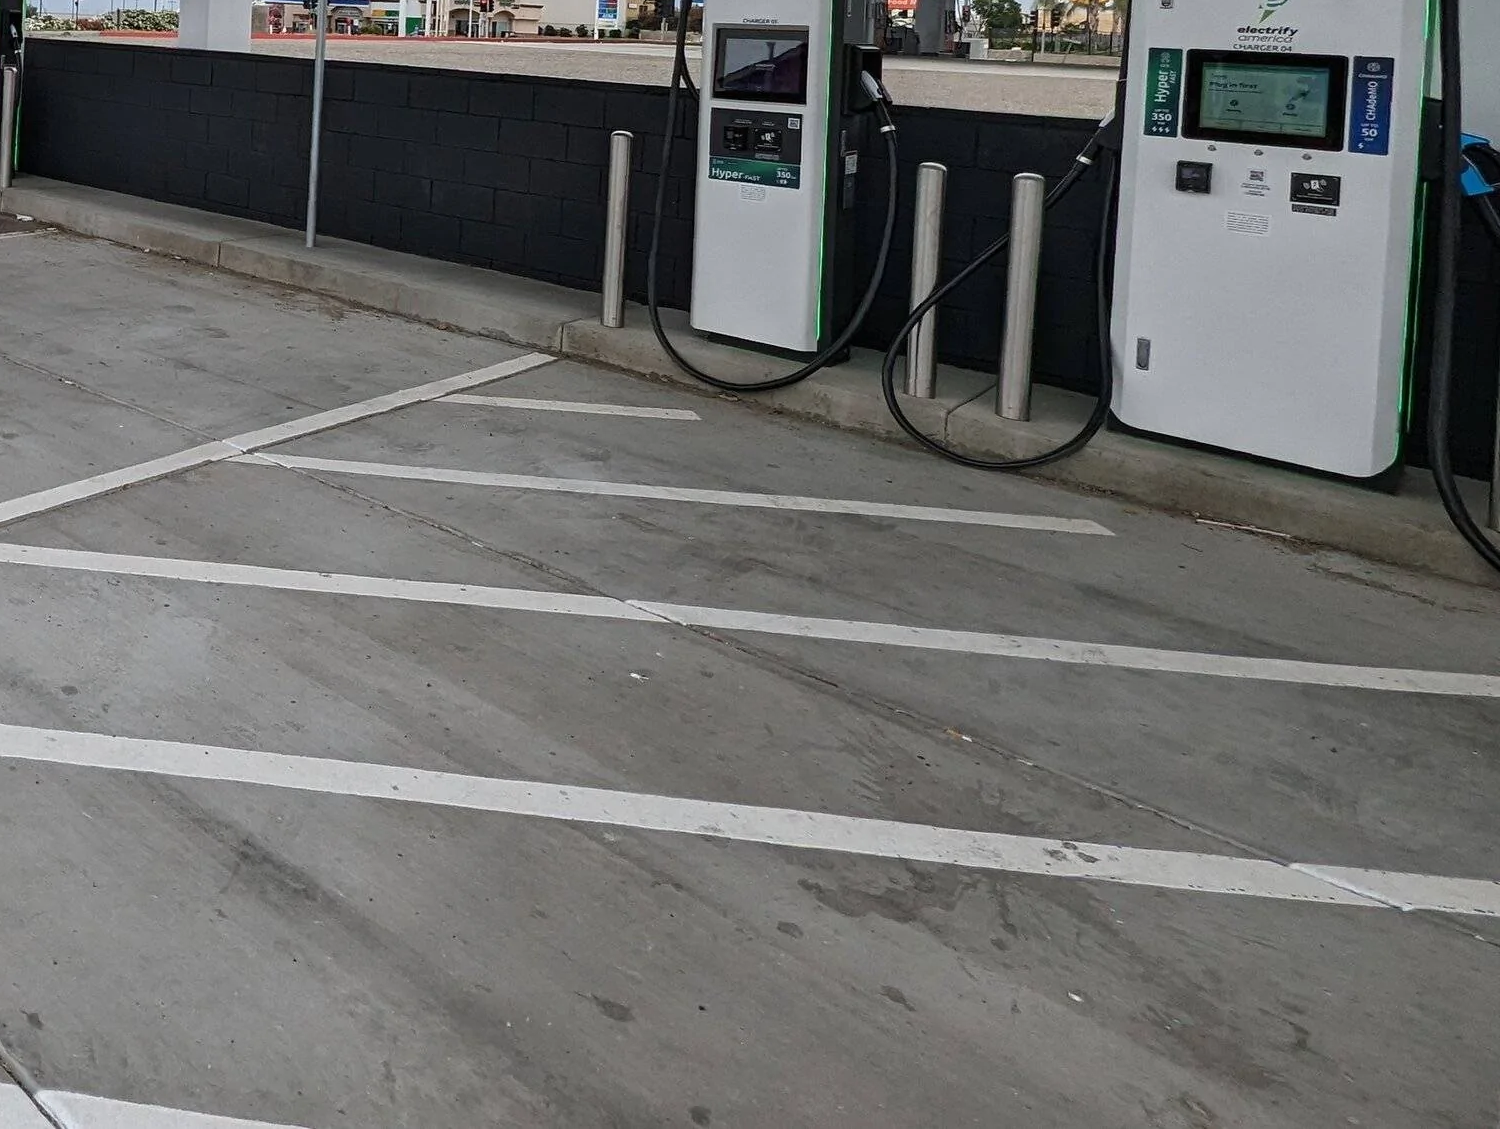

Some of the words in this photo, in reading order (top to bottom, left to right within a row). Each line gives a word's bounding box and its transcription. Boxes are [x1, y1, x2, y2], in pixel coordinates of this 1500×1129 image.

[1237, 25, 1299, 37] electrify
[1238, 35, 1294, 44] america
[1233, 43, 1279, 52] CHARGER
[1169, 71, 1177, 84] FAST
[1154, 70, 1171, 103] Hyper
[1365, 80, 1379, 121] CHAdeMO
[1151, 112, 1172, 122] 350
[1361, 128, 1378, 137] 50
[711, 167, 744, 180] Hyper
[776, 170, 791, 179] 350
